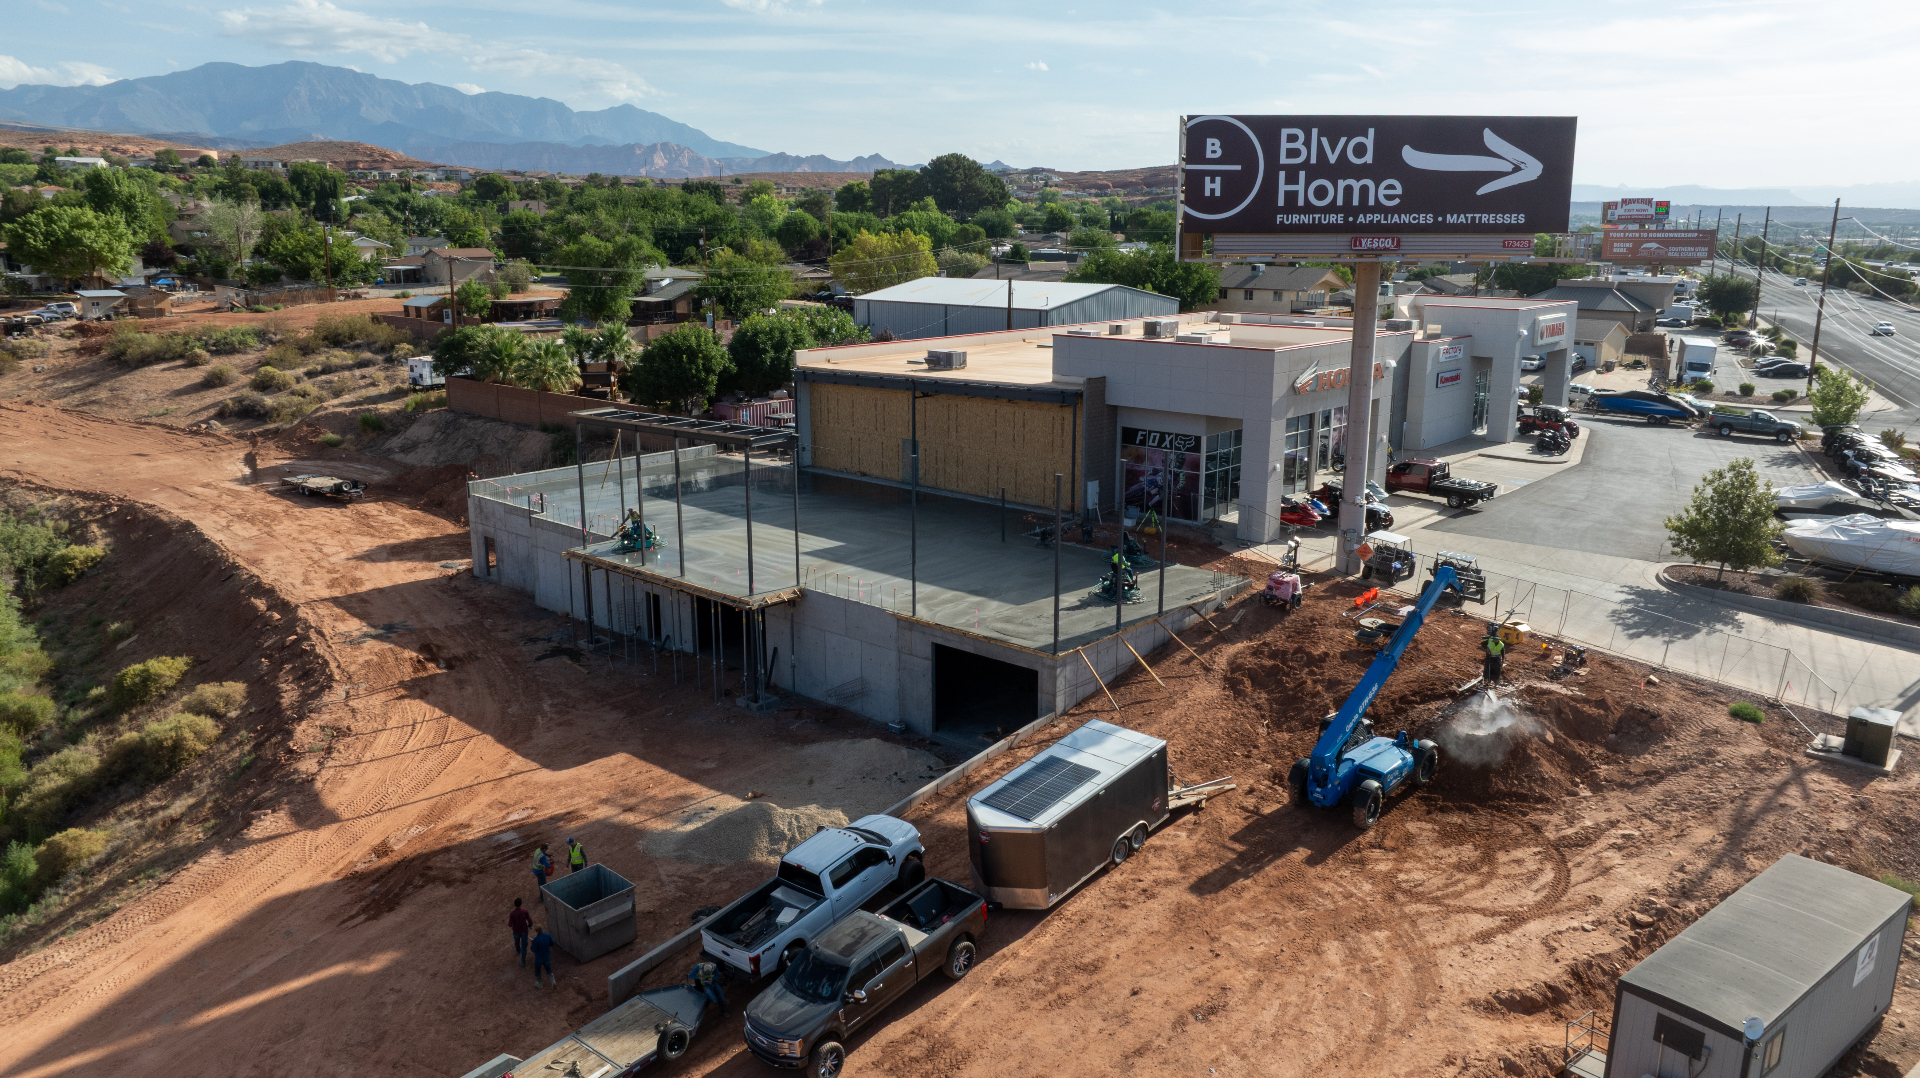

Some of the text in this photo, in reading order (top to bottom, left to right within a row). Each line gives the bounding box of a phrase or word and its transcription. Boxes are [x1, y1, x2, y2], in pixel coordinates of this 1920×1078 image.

[1206, 138, 1222, 158] B
[1279, 128, 1375, 164] Blvd
[1204, 176, 1221, 196] H
[1277, 170, 1403, 206] Home
[1620, 198, 1654, 209] MAVERIK
[1276, 213, 1526, 224] FURNITURE APPLIANCES MATTRESSES
[1360, 238, 1392, 248] YESCO
[1545, 321, 1565, 339] YAMAHA
[1316, 362, 1384, 391] HOA
[1440, 372, 1461, 384] Kawasaki
[1136, 430, 1174, 449] FOX
[1345, 713, 1359, 732] Genie
